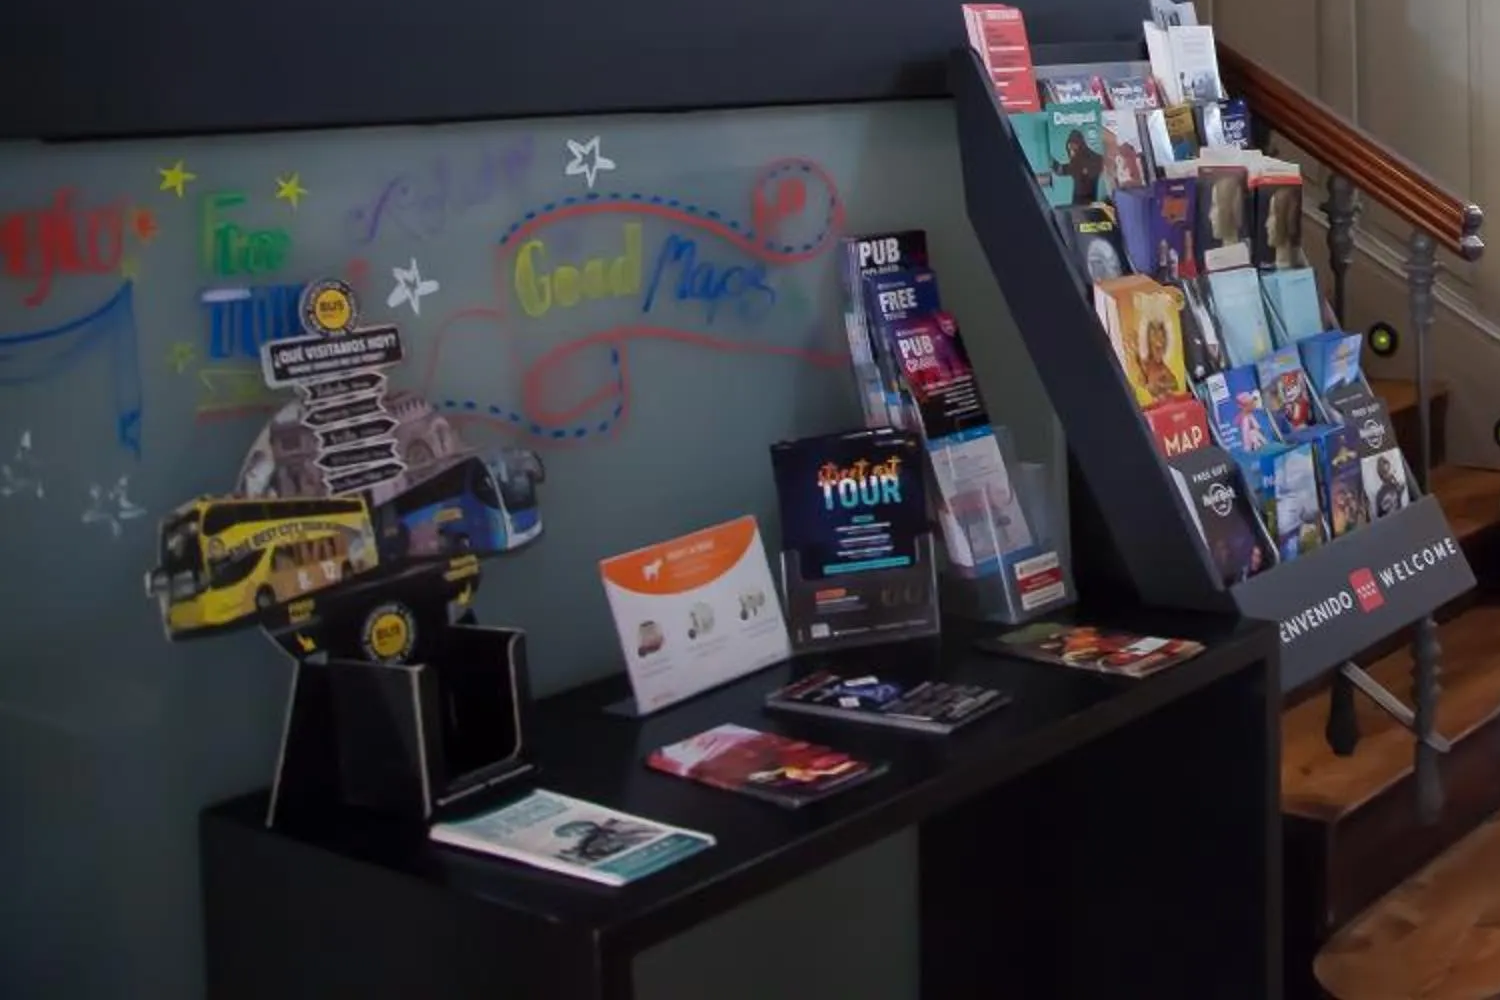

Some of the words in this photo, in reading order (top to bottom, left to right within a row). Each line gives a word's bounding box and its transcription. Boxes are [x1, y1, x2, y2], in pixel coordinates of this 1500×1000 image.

[858, 237, 900, 267] PUB
[513, 221, 643, 318] Good
[878, 286, 918, 313] FREE
[304, 338, 366, 360] VISITAMOS
[897, 335, 934, 358] PUB
[1163, 425, 1204, 457] MAP
[817, 474, 902, 511] TOUR
[1379, 537, 1457, 588] WELCOME
